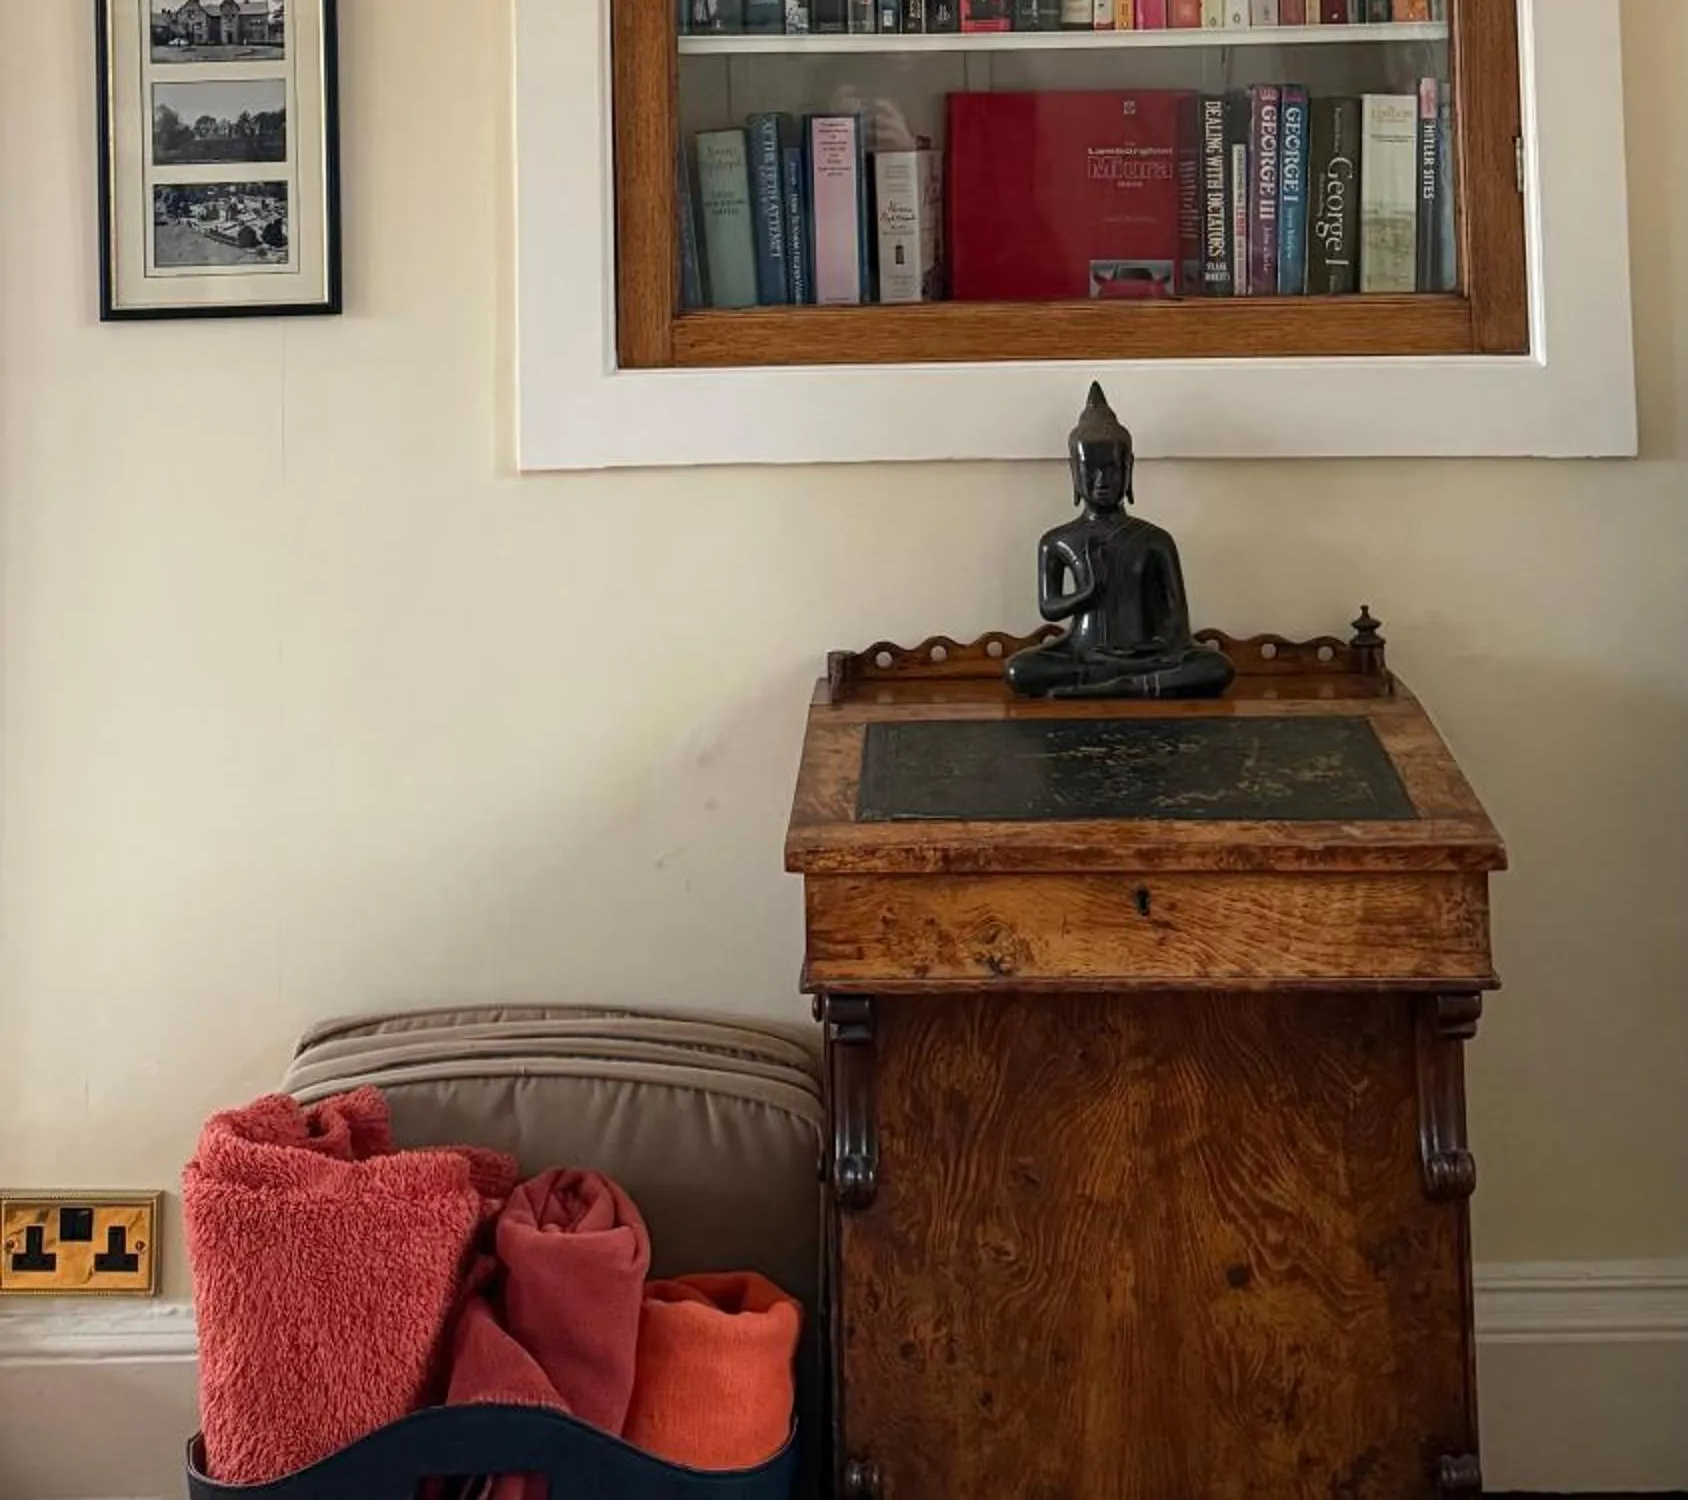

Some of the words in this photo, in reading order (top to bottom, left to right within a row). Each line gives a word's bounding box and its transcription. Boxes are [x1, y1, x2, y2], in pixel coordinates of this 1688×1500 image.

[1204, 100, 1223, 153] DEALING
[1422, 123, 1434, 165] HITLER
[1087, 156, 1173, 179] Miura
[1258, 104, 1277, 195] GEORGE
[1283, 106, 1300, 192] GEORGE
[1205, 154, 1223, 189] WITH
[1422, 168, 1434, 199] SITES
[1258, 199, 1276, 220] III
[1283, 194, 1299, 202] I
[1314, 155, 1353, 252] George
[1205, 191, 1224, 257] DICTATORS
[1325, 256, 1349, 265] I
